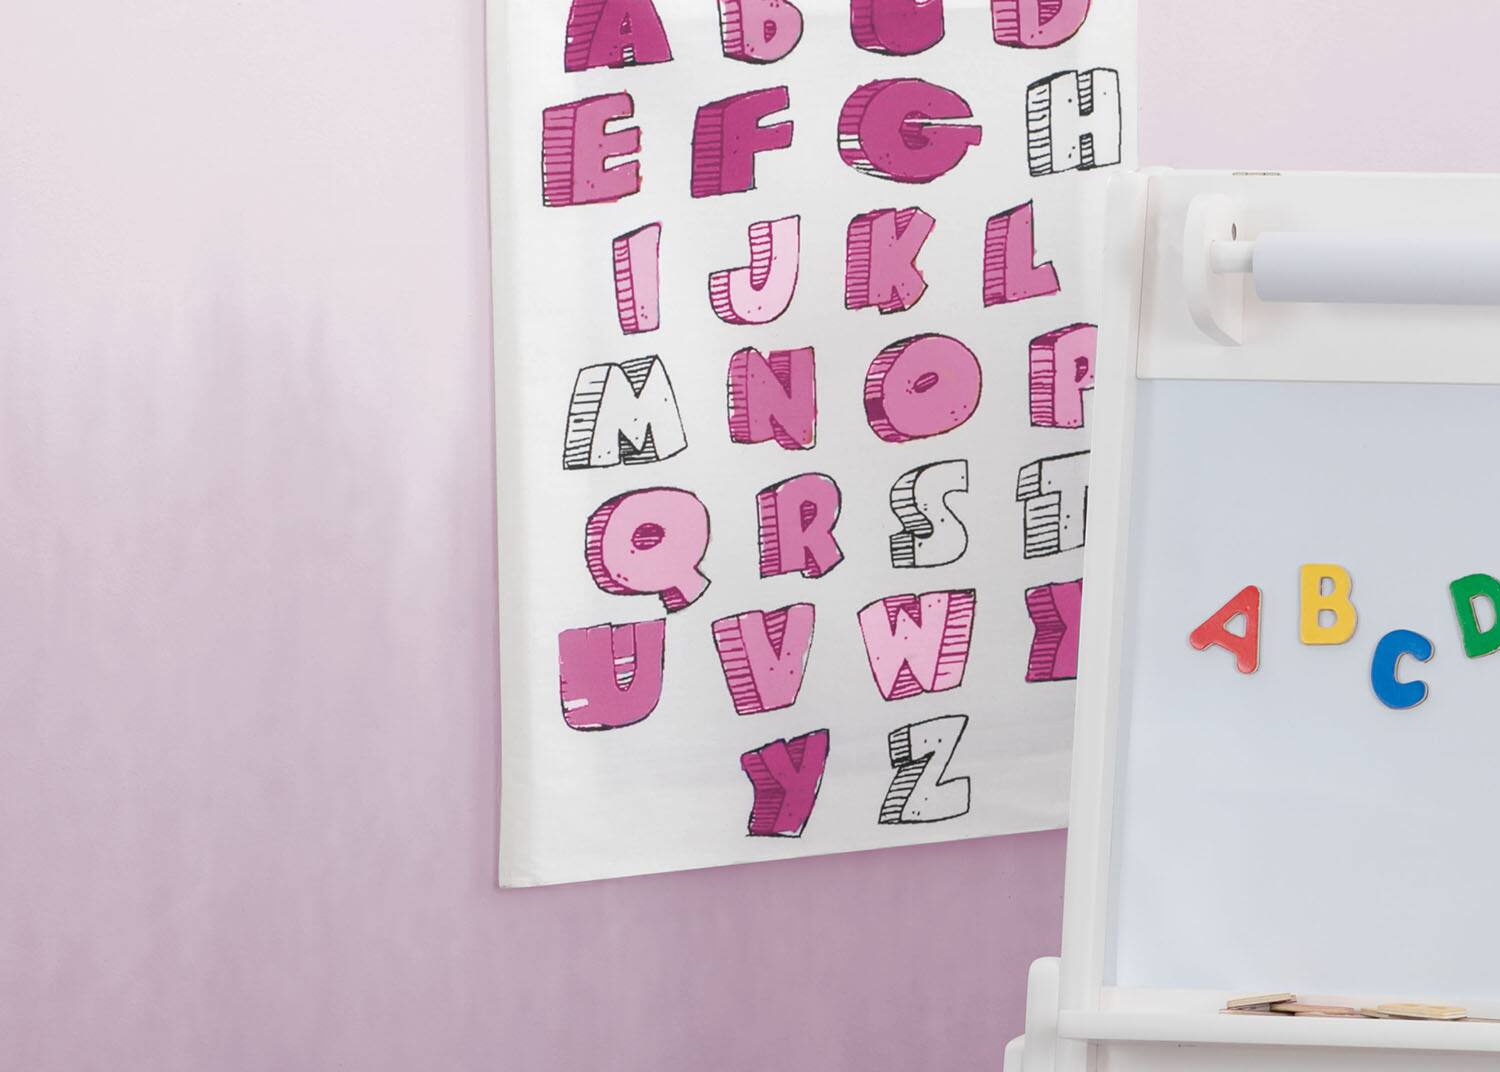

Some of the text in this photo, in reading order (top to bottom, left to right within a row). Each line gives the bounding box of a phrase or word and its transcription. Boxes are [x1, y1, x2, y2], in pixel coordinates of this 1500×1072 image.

[564, 0, 674, 72] A
[716, 0, 804, 65] B
[542, 67, 1122, 207] E F G H
[612, 200, 1061, 335] I J K L
[563, 323, 1098, 469] M N O P
[584, 486, 711, 614] Q
[755, 472, 845, 579] R
[889, 459, 969, 568] S
[558, 618, 667, 732] U
[711, 602, 816, 716] V
[857, 588, 976, 701] W
[740, 714, 970, 838] Y Z
